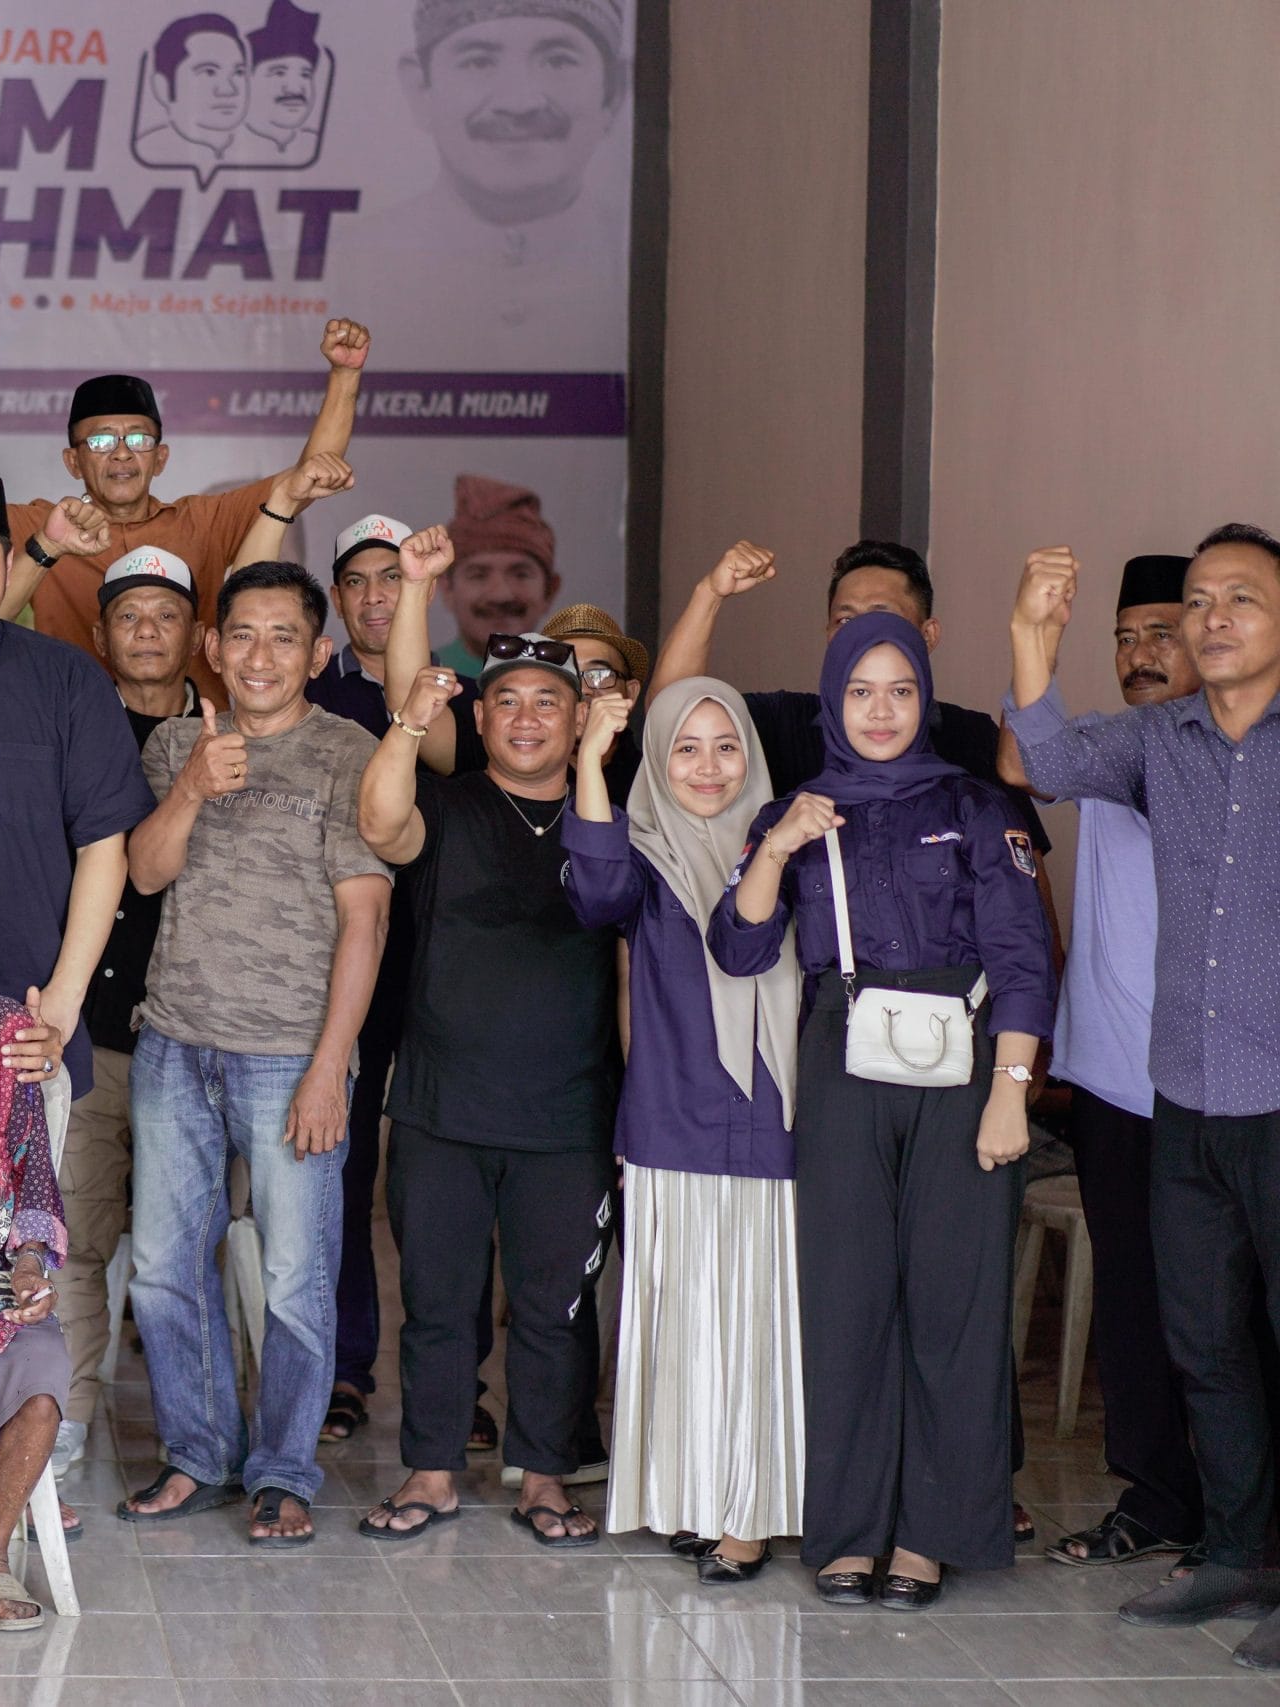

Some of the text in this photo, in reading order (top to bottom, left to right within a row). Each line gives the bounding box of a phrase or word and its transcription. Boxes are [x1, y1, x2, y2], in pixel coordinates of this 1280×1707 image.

[90, 293, 328, 318] Maju dan Sejahtera
[228, 391, 549, 418] LAPANN KERJA MUDAH
